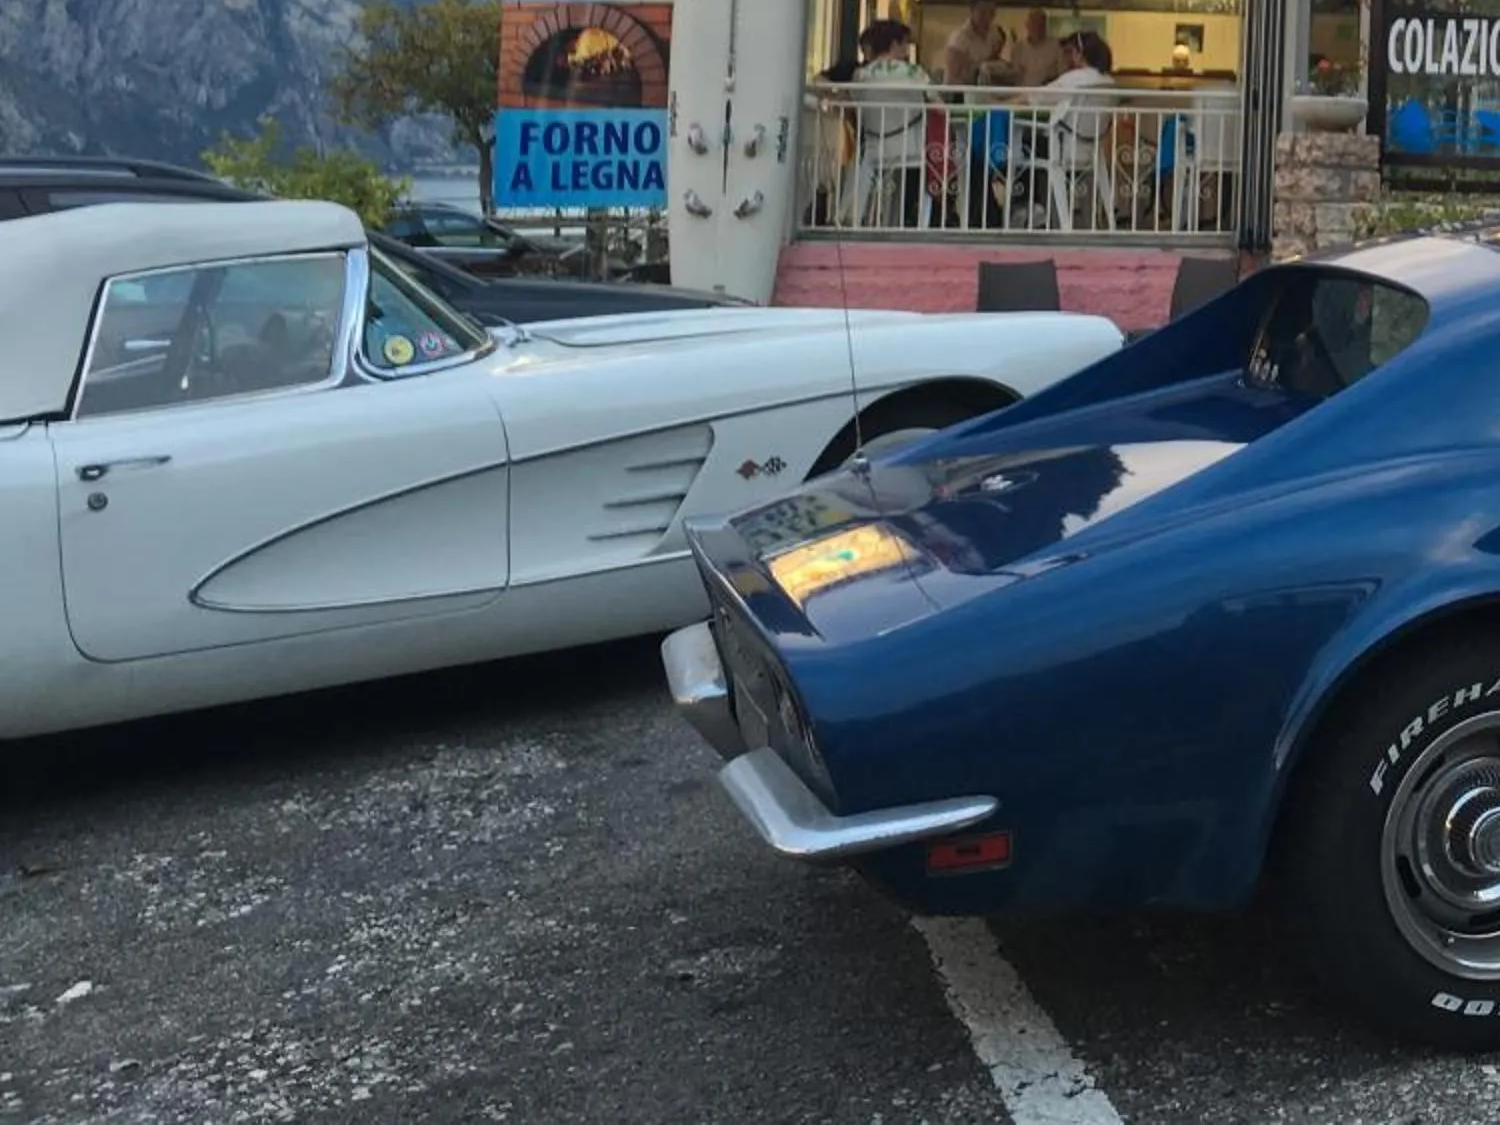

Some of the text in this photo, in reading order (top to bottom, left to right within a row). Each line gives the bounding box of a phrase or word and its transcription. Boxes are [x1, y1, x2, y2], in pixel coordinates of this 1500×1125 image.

[519, 120, 661, 156] FORNO
[510, 160, 665, 191] A LEGNA
